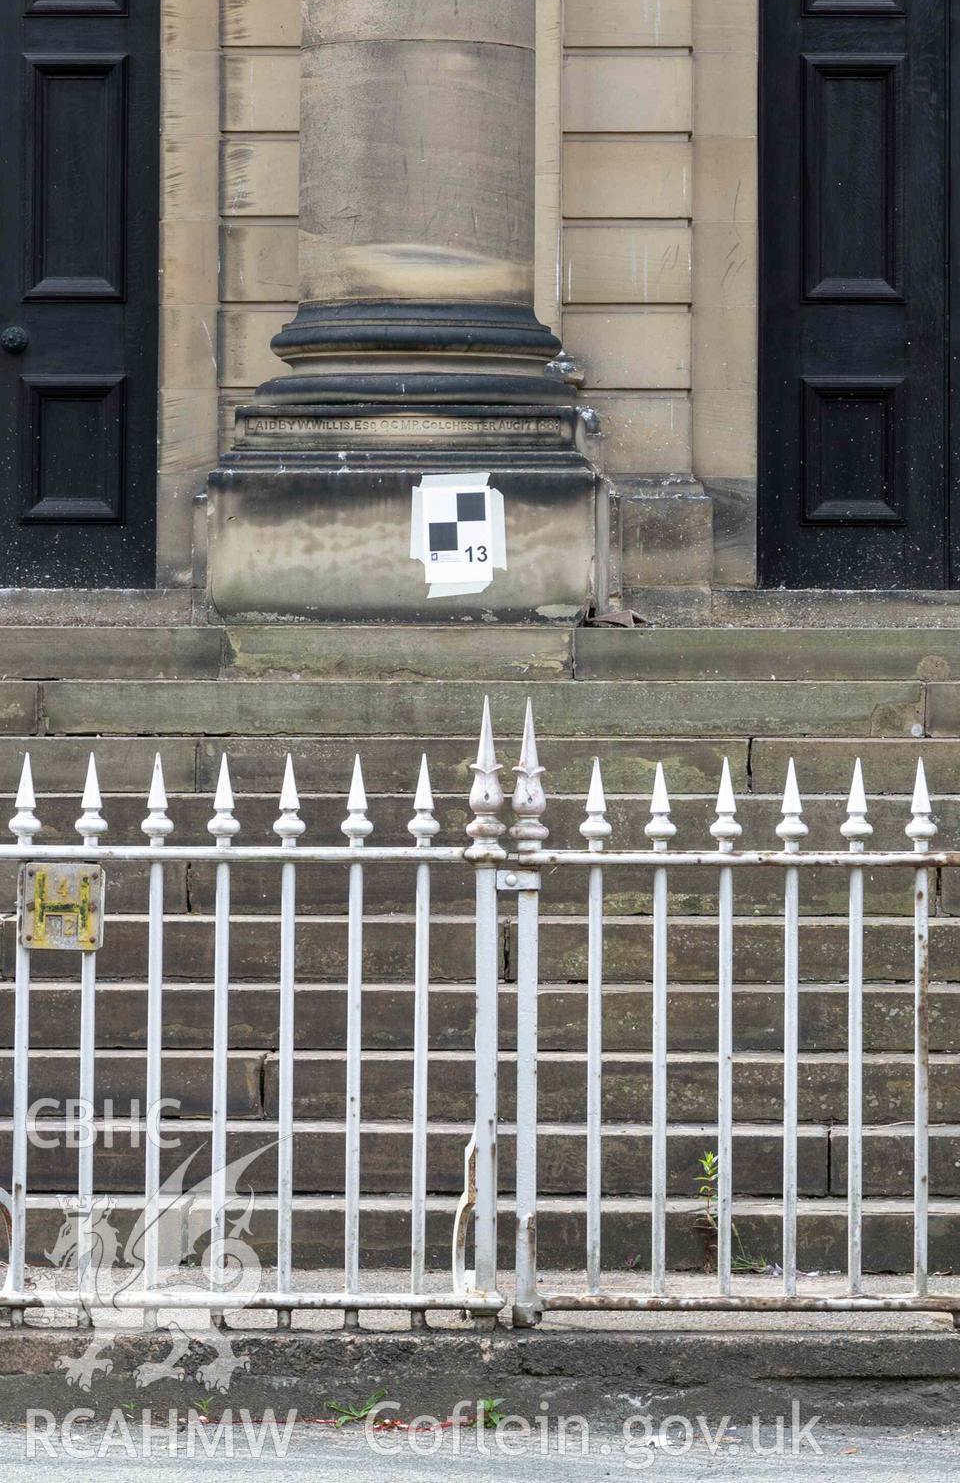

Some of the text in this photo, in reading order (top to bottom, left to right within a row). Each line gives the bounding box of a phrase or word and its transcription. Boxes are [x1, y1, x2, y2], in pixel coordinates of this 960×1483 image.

[247, 419, 277, 431] LAID
[278, 419, 296, 431] BY
[422, 419, 496, 431] COLCHESTER
[465, 545, 488, 563] 13
[34, 872, 89, 942] H
